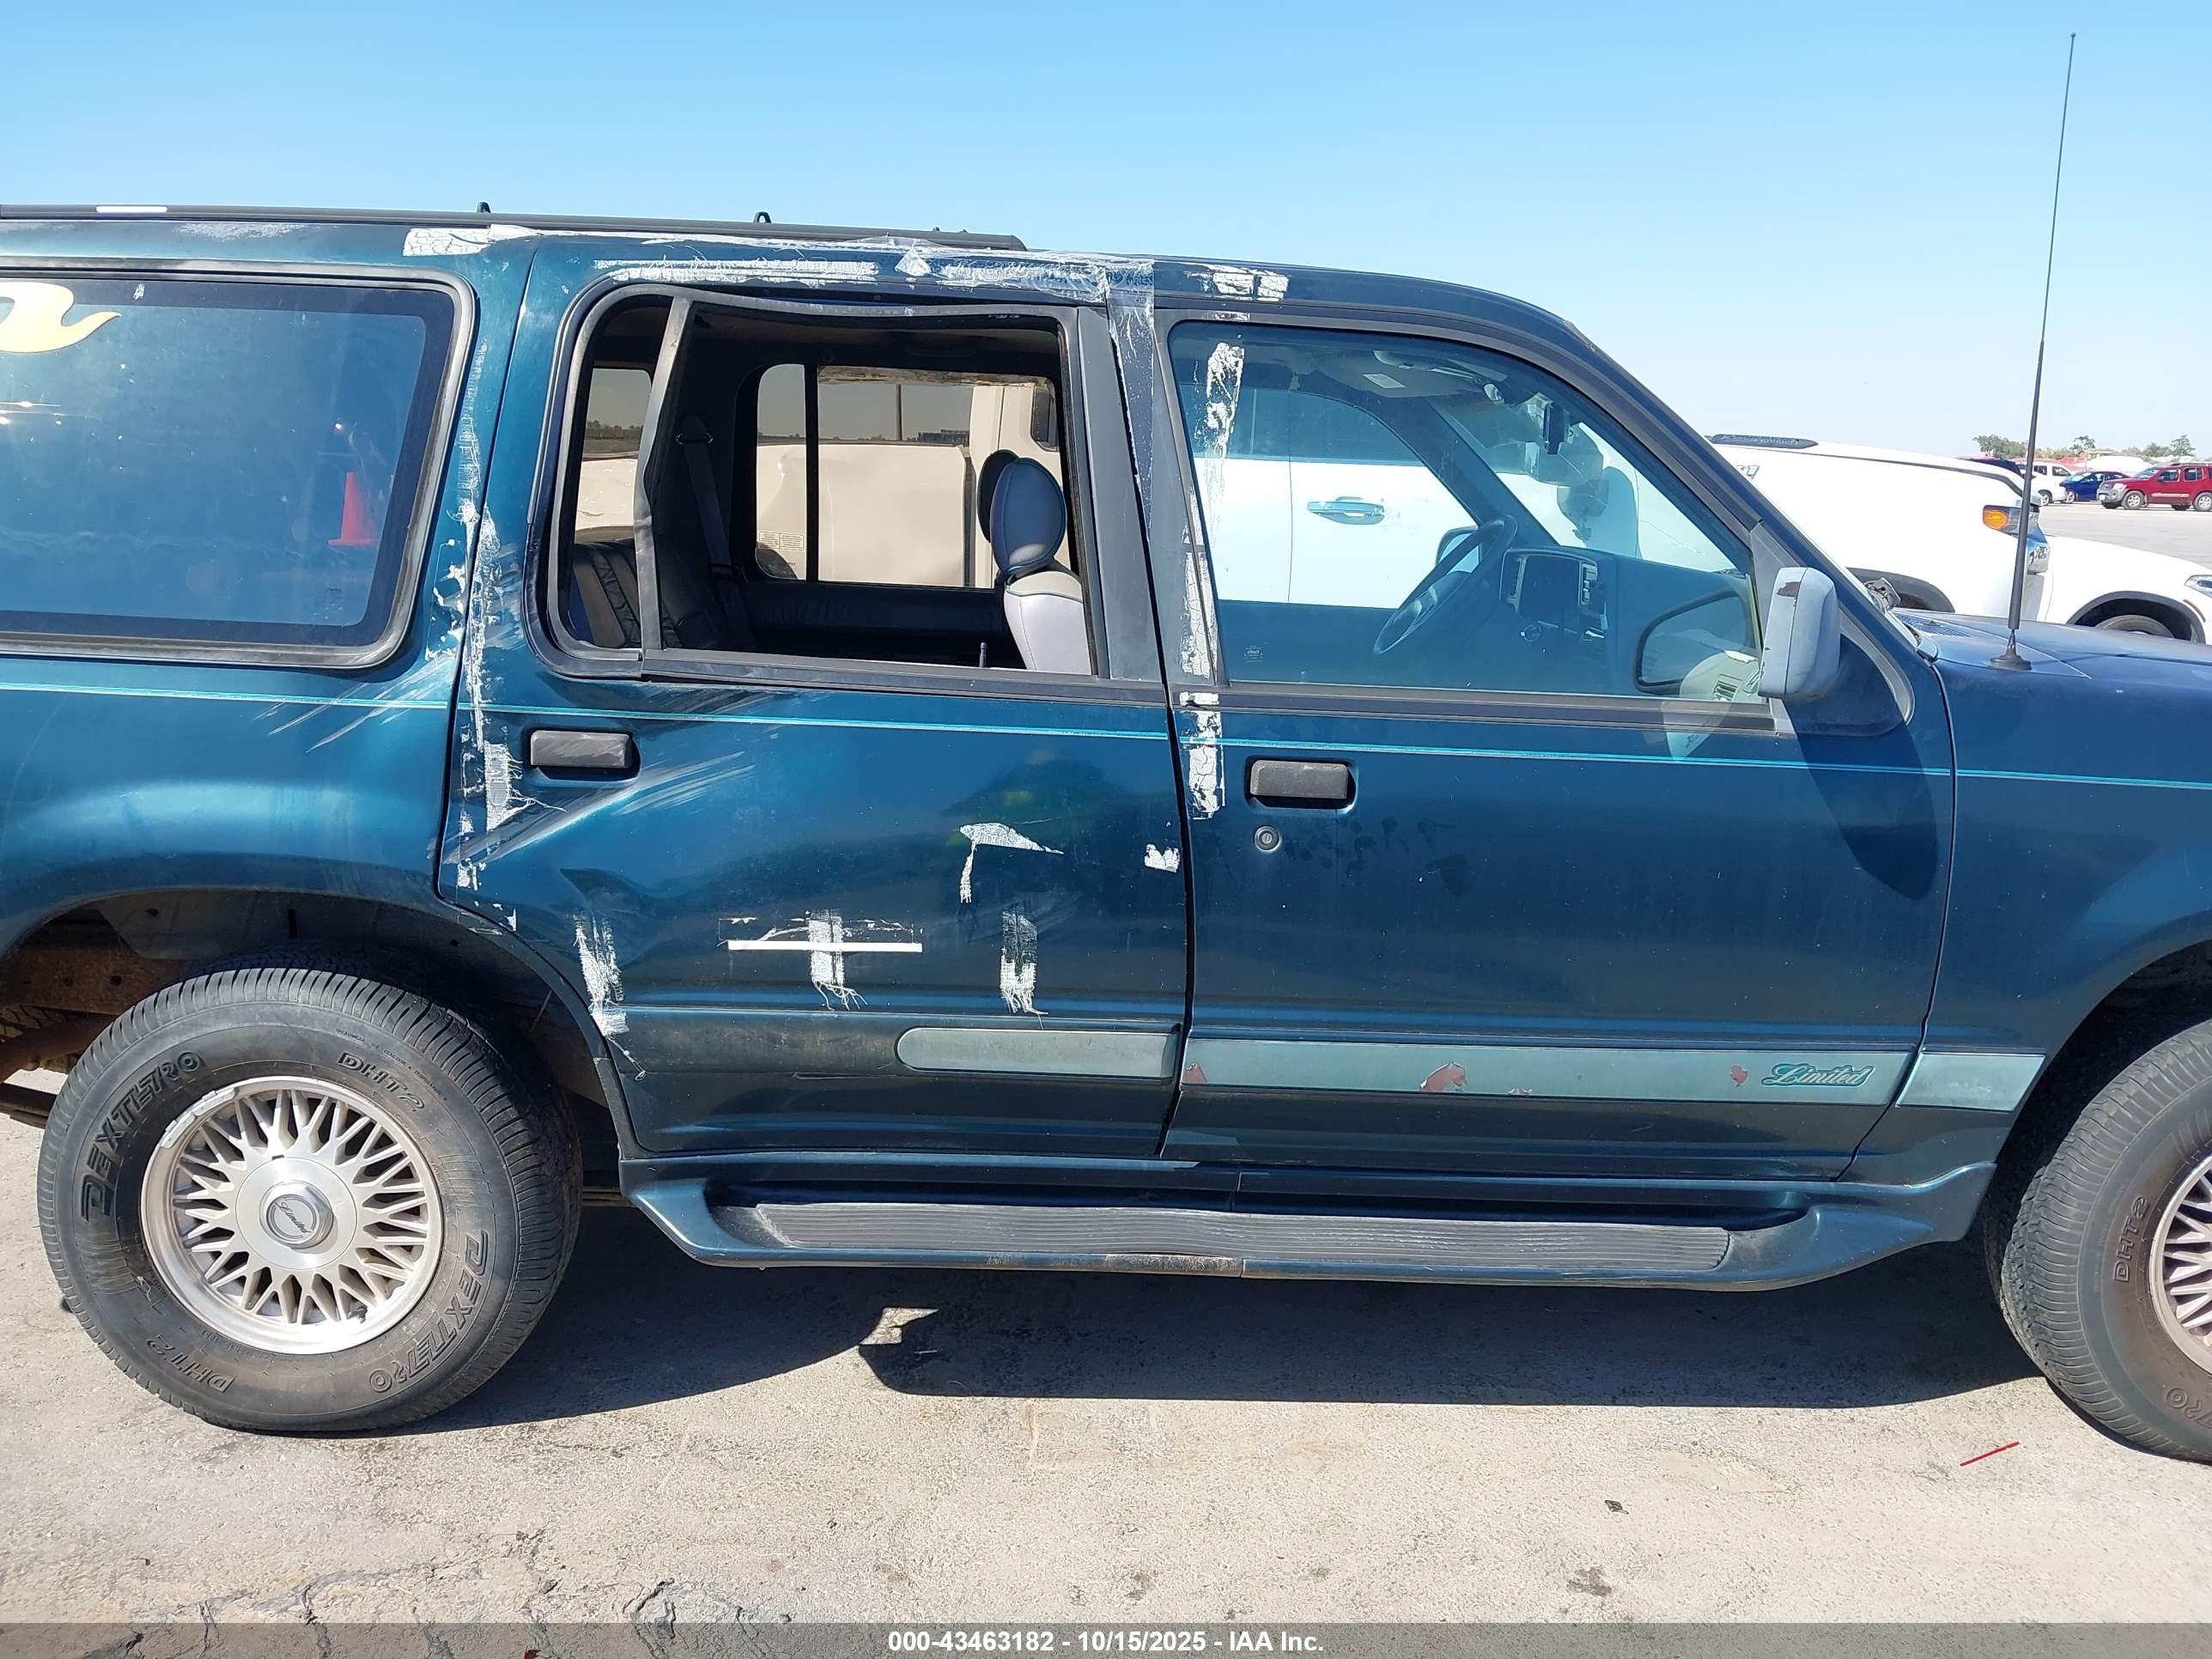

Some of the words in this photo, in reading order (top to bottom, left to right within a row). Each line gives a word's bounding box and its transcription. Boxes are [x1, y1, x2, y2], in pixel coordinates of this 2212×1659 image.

[336, 1050, 426, 1113] DHT2
[1760, 1062, 1875, 1087] Limited
[81, 1049, 202, 1223] DEXTERO
[273, 1201, 312, 1234] Limited
[2112, 1194, 2150, 1283] DHT2
[369, 1229, 489, 1393] DEXTERO
[146, 1334, 236, 1394] DHT2
